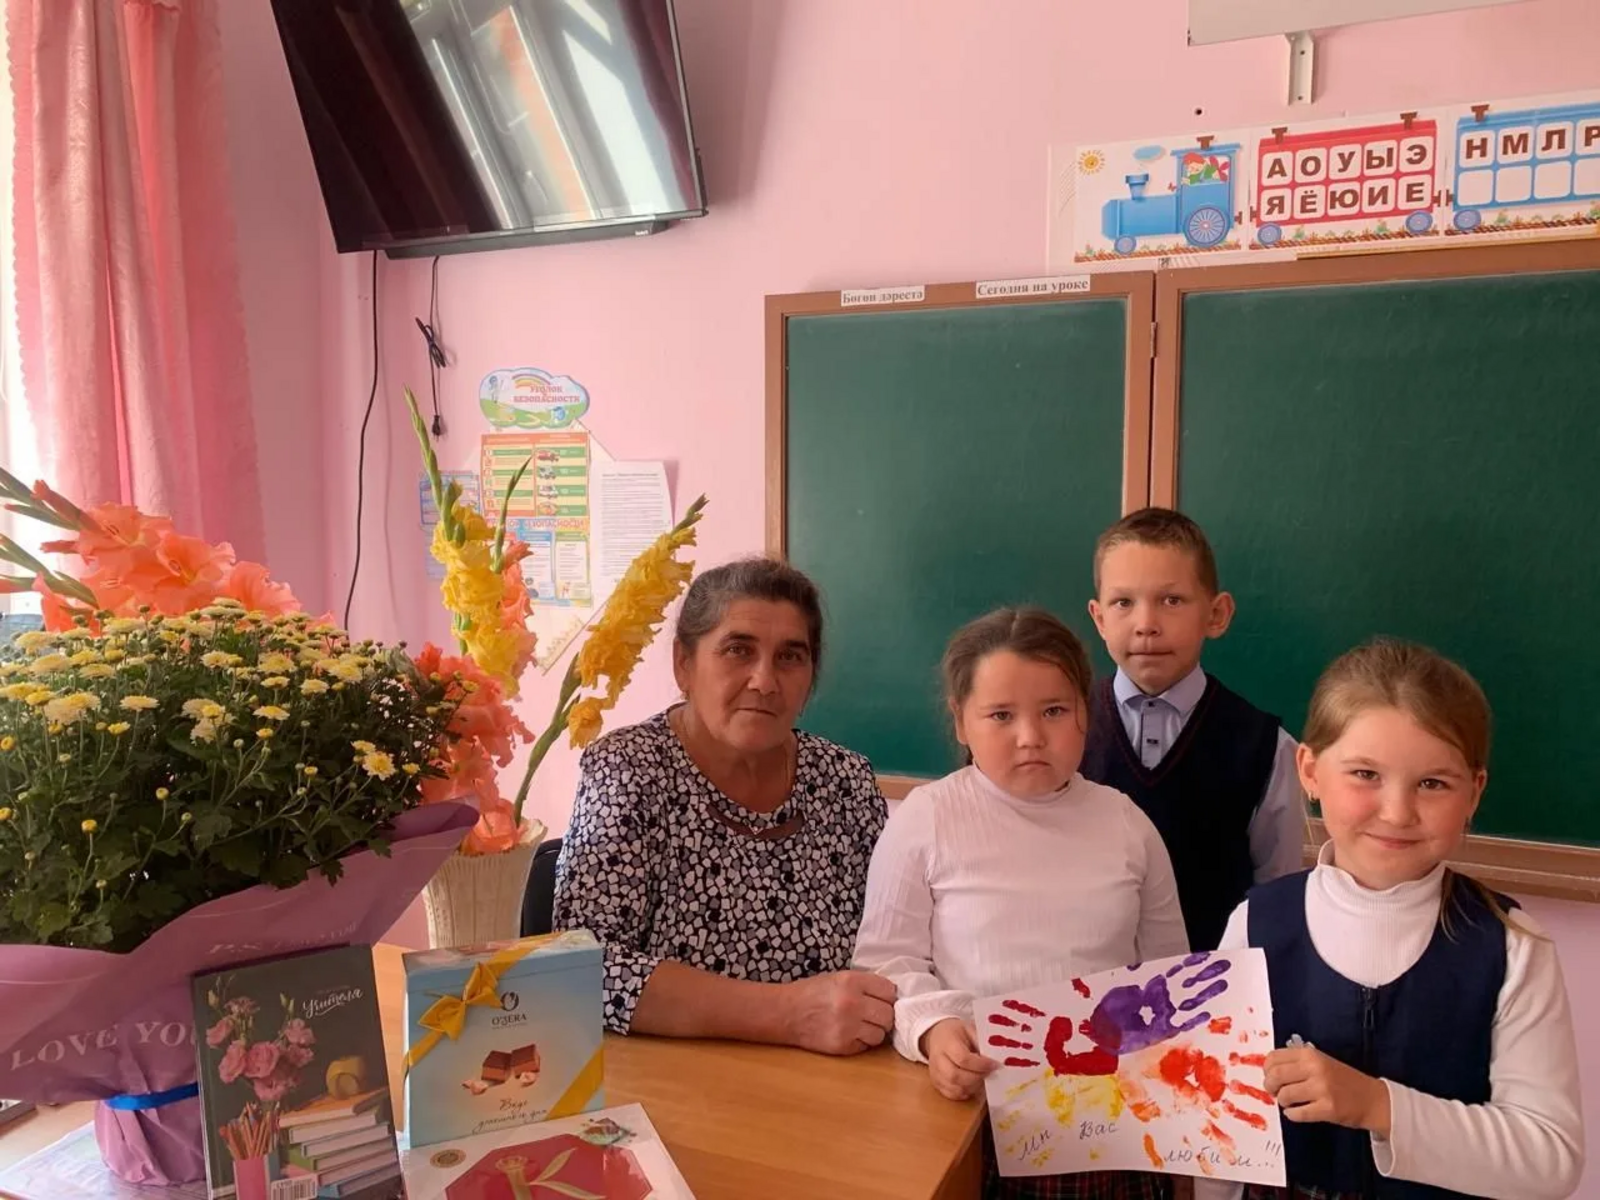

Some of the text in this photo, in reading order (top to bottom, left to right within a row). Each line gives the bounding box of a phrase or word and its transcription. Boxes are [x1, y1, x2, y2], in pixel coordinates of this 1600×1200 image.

[1465, 137, 1488, 159] Н
[1502, 132, 1529, 155] М
[1541, 128, 1566, 151] Л
[1267, 144, 1427, 179] А О У Ы Э
[1265, 182, 1425, 216] Я Ё Ю И Е
[977, 280, 1089, 296] Сегодня на уроке
[513, 395, 580, 404] БЕЗОПАСНОСТИ
[10, 1020, 197, 1071] LOVE YO
